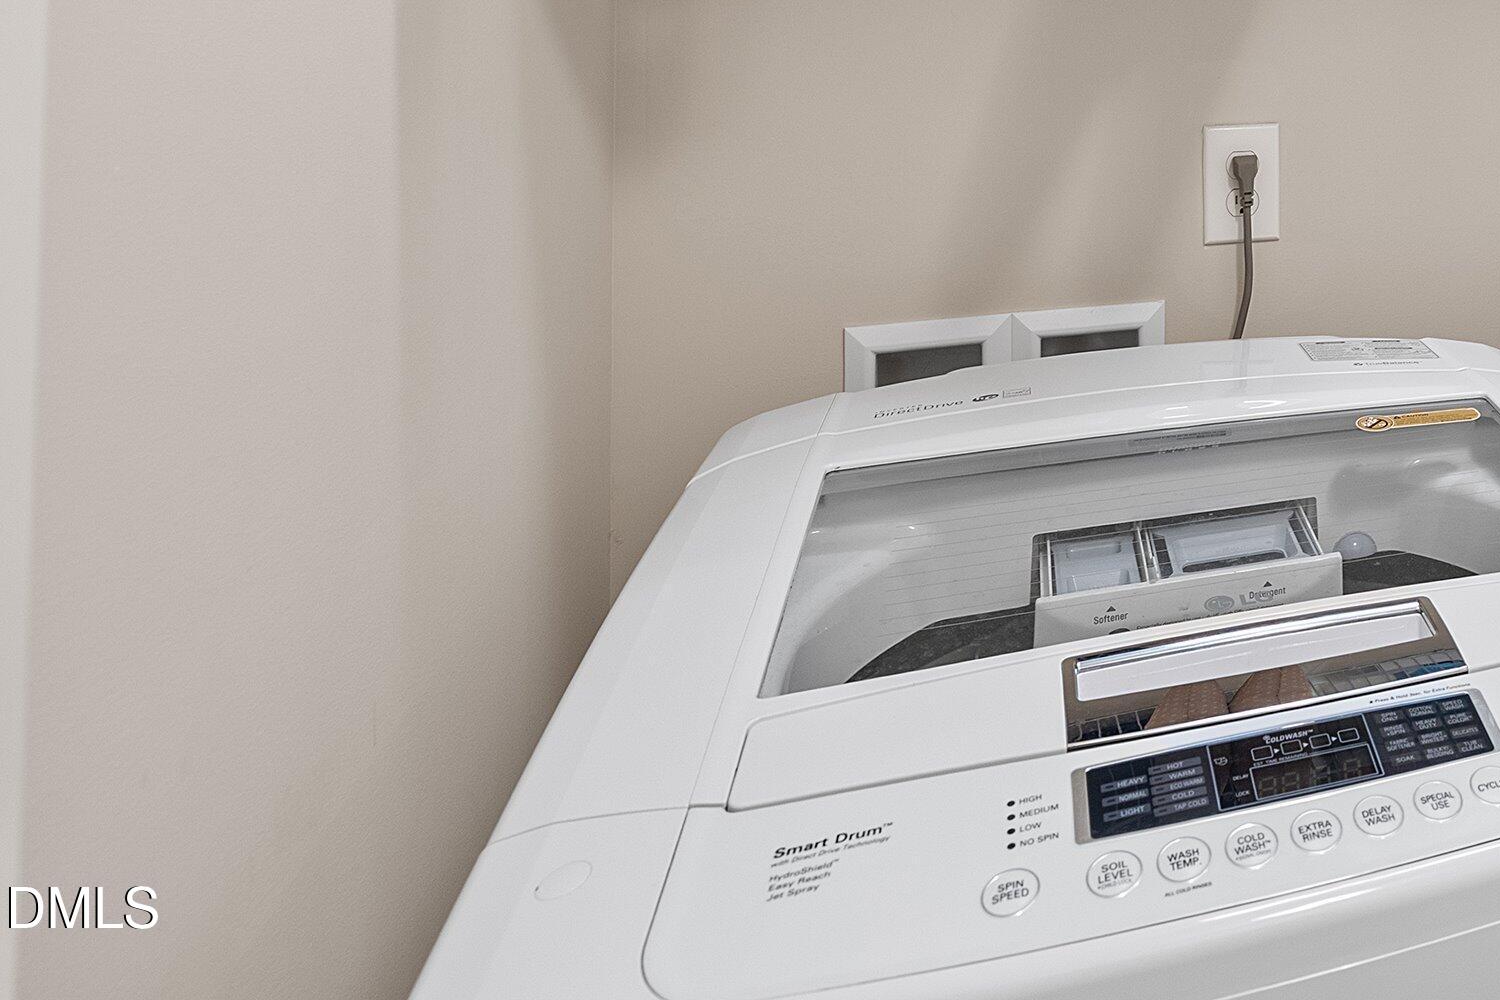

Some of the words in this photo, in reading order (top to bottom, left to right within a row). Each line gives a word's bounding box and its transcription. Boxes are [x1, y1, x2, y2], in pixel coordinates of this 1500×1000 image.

[1249, 587, 1286, 599] Detergent
[1093, 612, 1128, 625] Softener
[1446, 683, 1470, 691] Functions
[1381, 715, 1398, 723] ONLY
[1415, 718, 1437, 726] HEAVY
[1451, 727, 1479, 736] DELICATES
[1386, 741, 1415, 752] SOFTENER
[1461, 744, 1484, 753] CLEAN
[1166, 761, 1184, 770] HOT
[1396, 755, 1415, 763] SOAK
[1168, 769, 1196, 780] WARM
[1117, 777, 1145, 788] HEAVY
[1170, 782, 1182, 790] ECO
[1183, 778, 1203, 787] WARM
[1019, 794, 1043, 805] HIGH
[1119, 791, 1146, 801] NORMAL
[1172, 790, 1195, 800] COLD
[1420, 790, 1454, 805] SPECIAL
[1019, 803, 1059, 818] MEDIUM
[1174, 802, 1187, 811] TAP
[1188, 798, 1207, 808] COLD
[1430, 800, 1450, 811] USE
[1120, 806, 1145, 817] LIGHT
[1361, 805, 1392, 819] DELAY
[1365, 813, 1396, 827] WASH
[1020, 822, 1042, 833] LOW
[1298, 820, 1332, 835] EXTRA
[1020, 838, 1035, 847] NO
[1037, 832, 1059, 843] SPIN
[1237, 832, 1265, 846] COLD
[1302, 829, 1333, 843] RINSE
[771, 859, 789, 868] with
[791, 852, 816, 863] Direct
[818, 847, 840, 856] Drive
[843, 836, 891, 850] Technology
[773, 838, 828, 859] Smart
[1167, 848, 1200, 862] WASH
[1101, 861, 1127, 874] SOIL
[768, 881, 796, 892] Easy
[797, 872, 831, 884] Reach
[1097, 868, 1133, 884] LEVEL
[997, 880, 1024, 893] SPIN
[1178, 887, 1191, 895] COLD
[1192, 882, 1212, 891] RINSES
[766, 893, 784, 902] Jet
[787, 885, 819, 897] Spray
[991, 887, 1029, 905] SPEED
